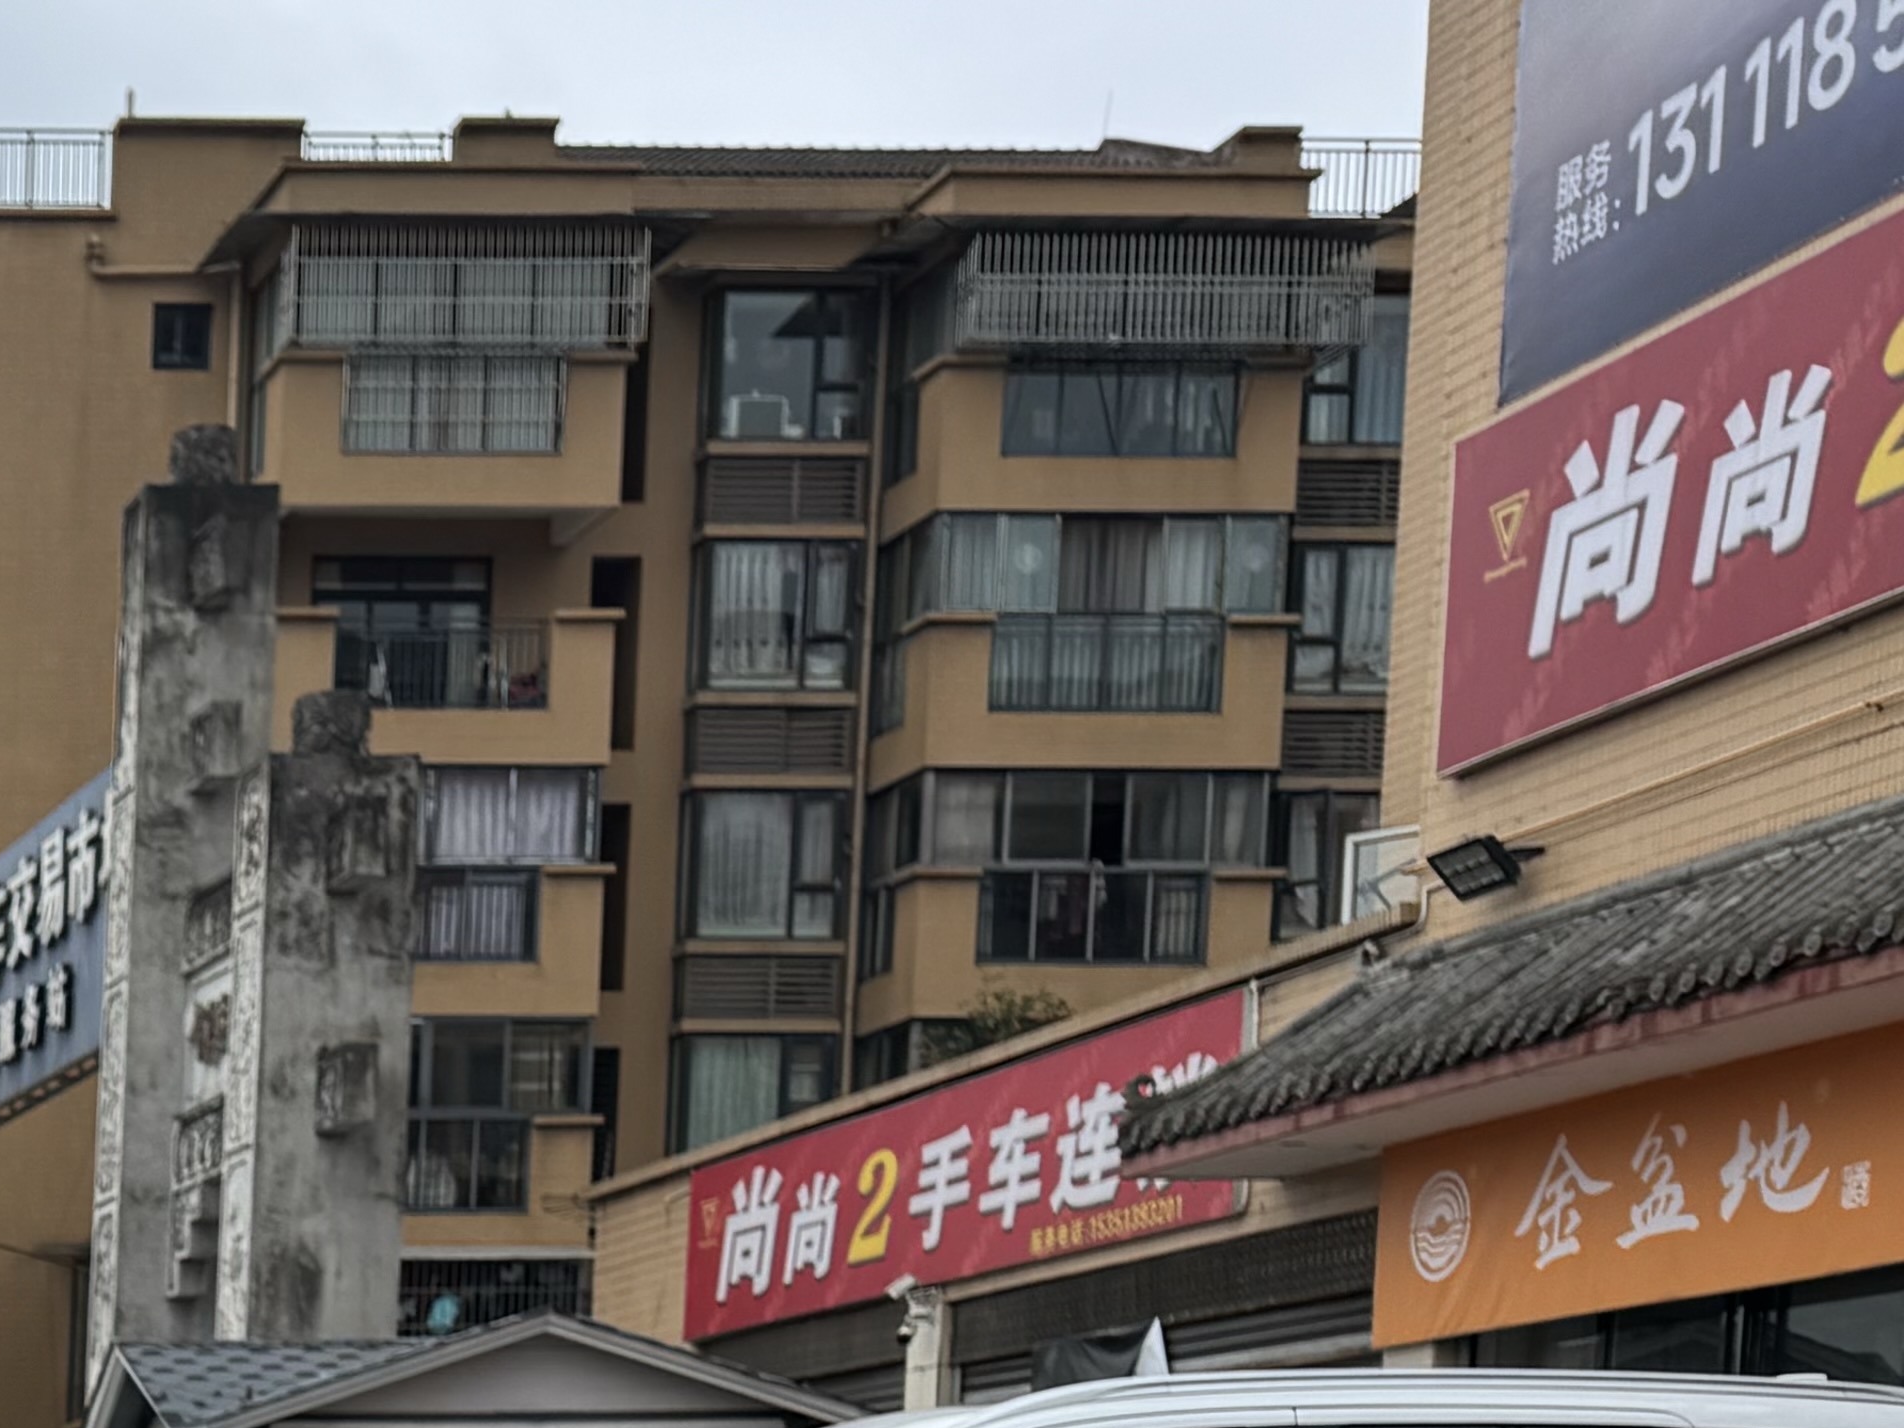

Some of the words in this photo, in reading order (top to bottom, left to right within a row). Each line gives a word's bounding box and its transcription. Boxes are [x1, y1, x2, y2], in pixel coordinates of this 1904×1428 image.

[1556, 139, 1612, 212] 服务
[1514, 1100, 1832, 1272] 金盆地
